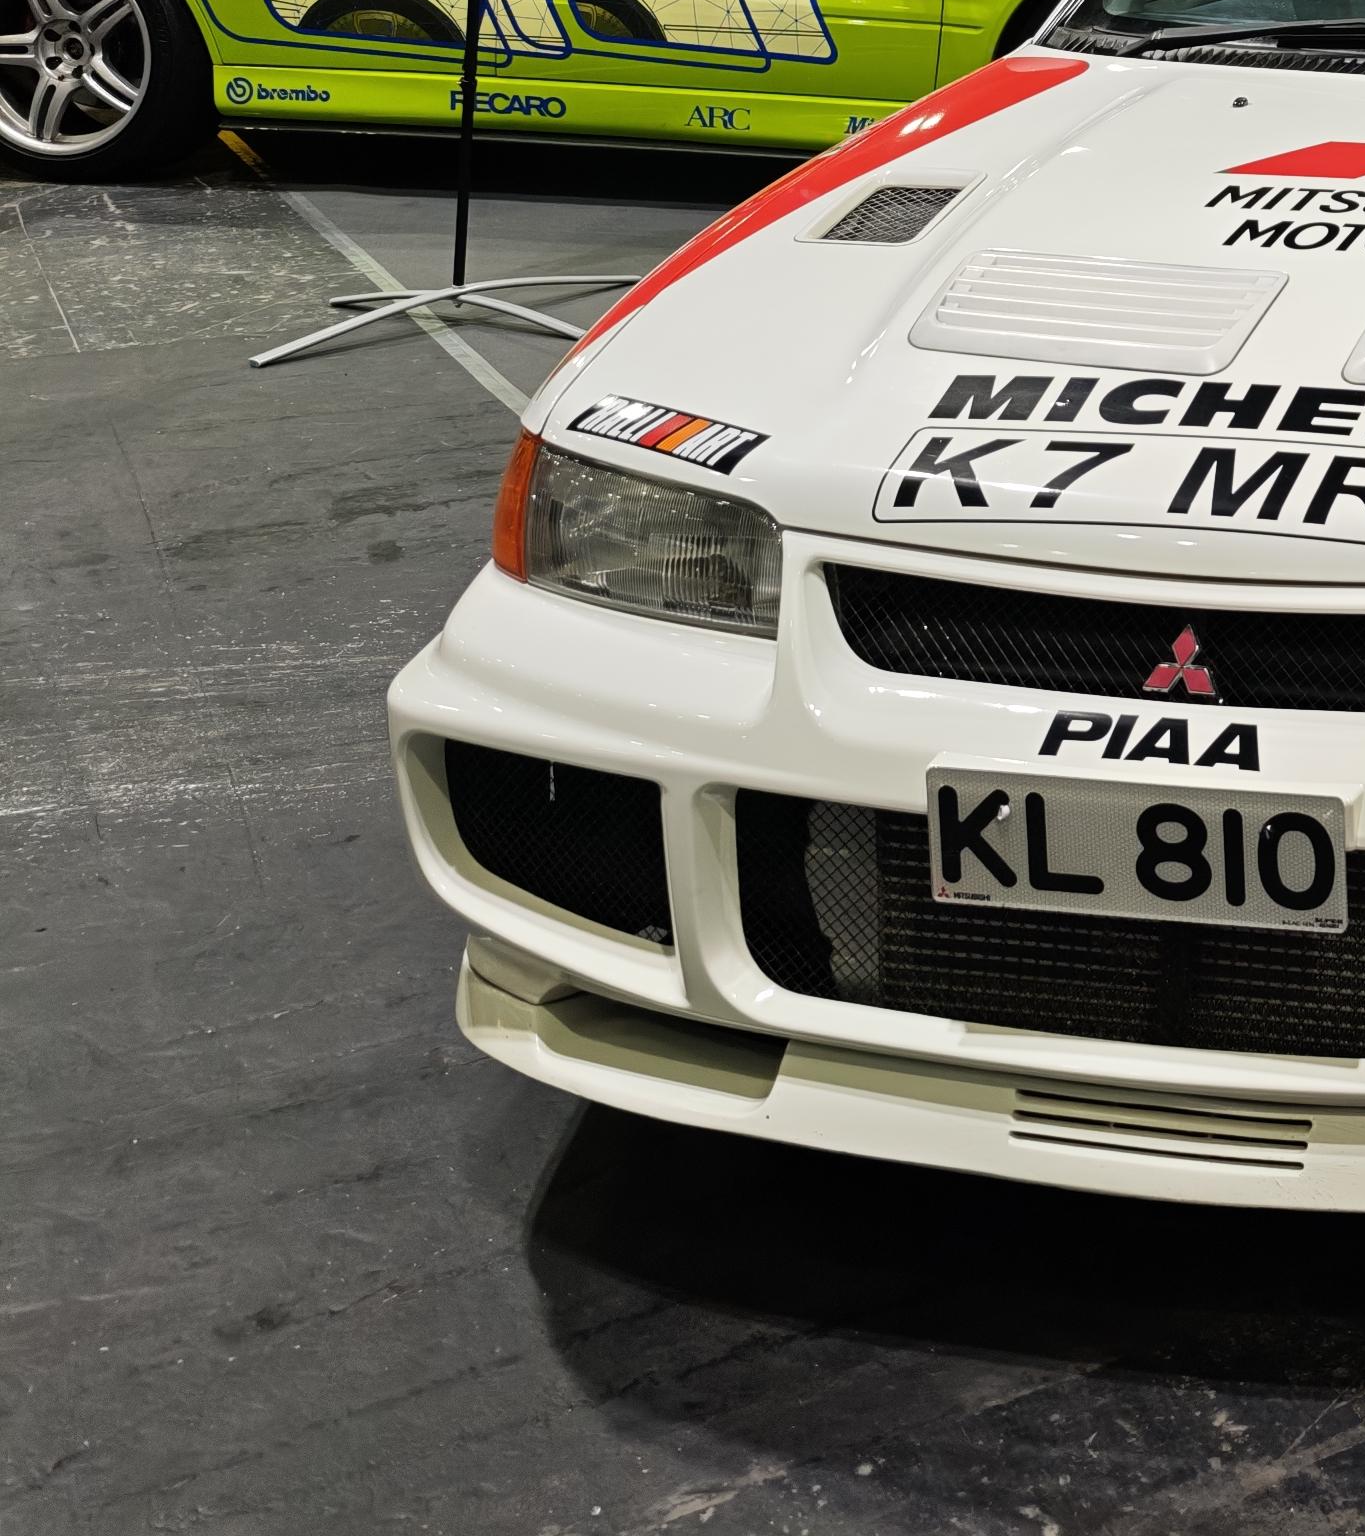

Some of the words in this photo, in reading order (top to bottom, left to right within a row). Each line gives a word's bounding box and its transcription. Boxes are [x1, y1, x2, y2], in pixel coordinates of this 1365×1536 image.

[257, 83, 331, 102] brembo
[685, 104, 751, 131] ARC
[577, 398, 677, 445] RALLI
[671, 419, 760, 467] ART
[1037, 709, 1261, 772] PIAA
[937, 784, 1105, 895] KL
[1135, 802, 1336, 911] 810
[952, 891, 992, 902] MITSUBISHI
